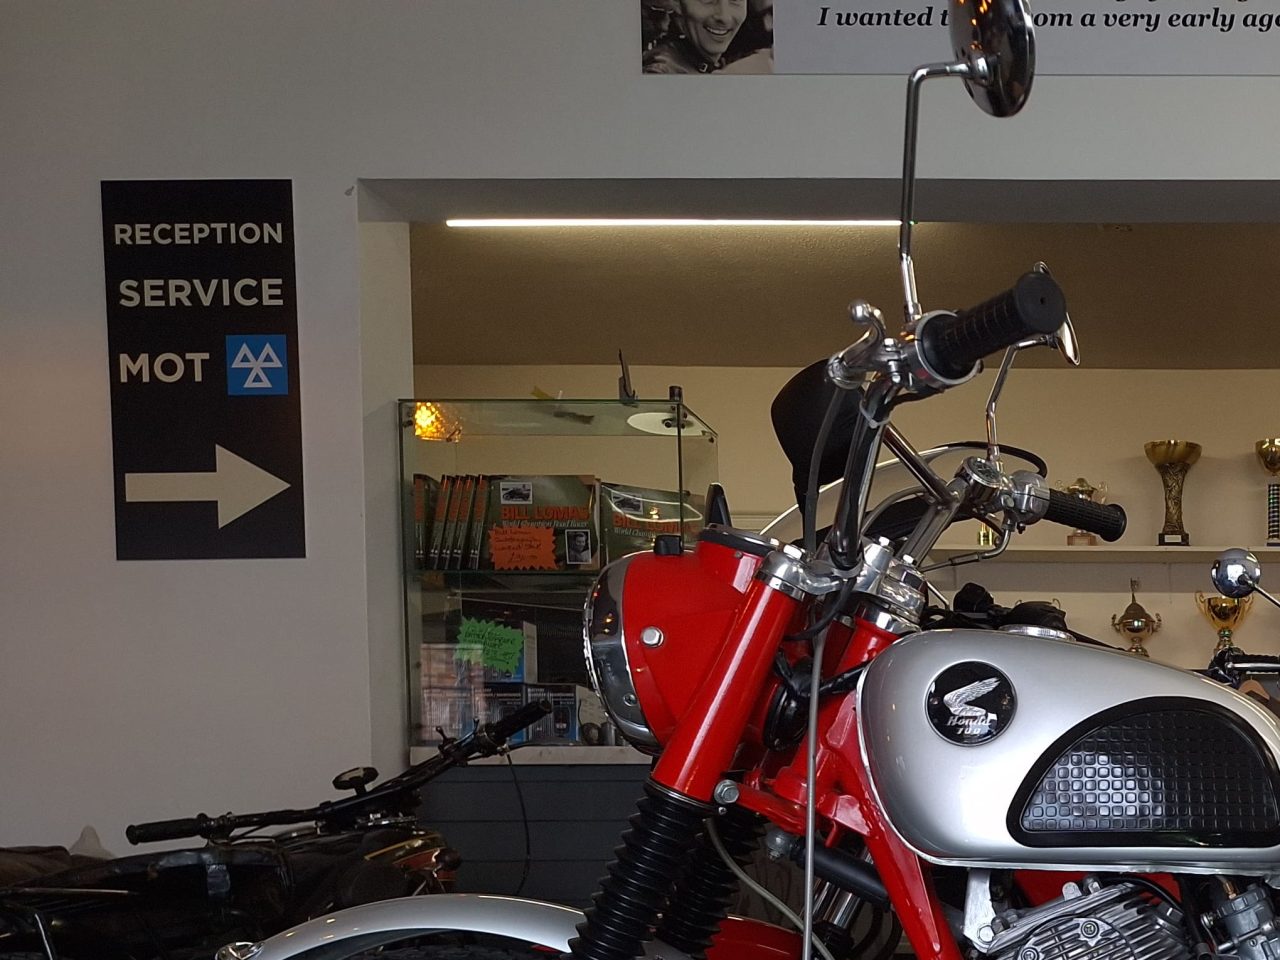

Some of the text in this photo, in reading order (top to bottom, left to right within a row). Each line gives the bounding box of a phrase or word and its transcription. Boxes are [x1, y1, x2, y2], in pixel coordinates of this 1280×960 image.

[816, 6, 830, 27] I
[834, 6, 933, 28] wanted
[1080, 12, 1096, 28] a
[1102, 12, 1161, 33] very
[1167, 7, 1236, 33] early
[114, 222, 283, 245] RECEPTION
[118, 278, 284, 307] SERVICE
[119, 352, 210, 383] MOT
[501, 505, 590, 520] BILL LOMAS
[946, 715, 991, 726] Honda
